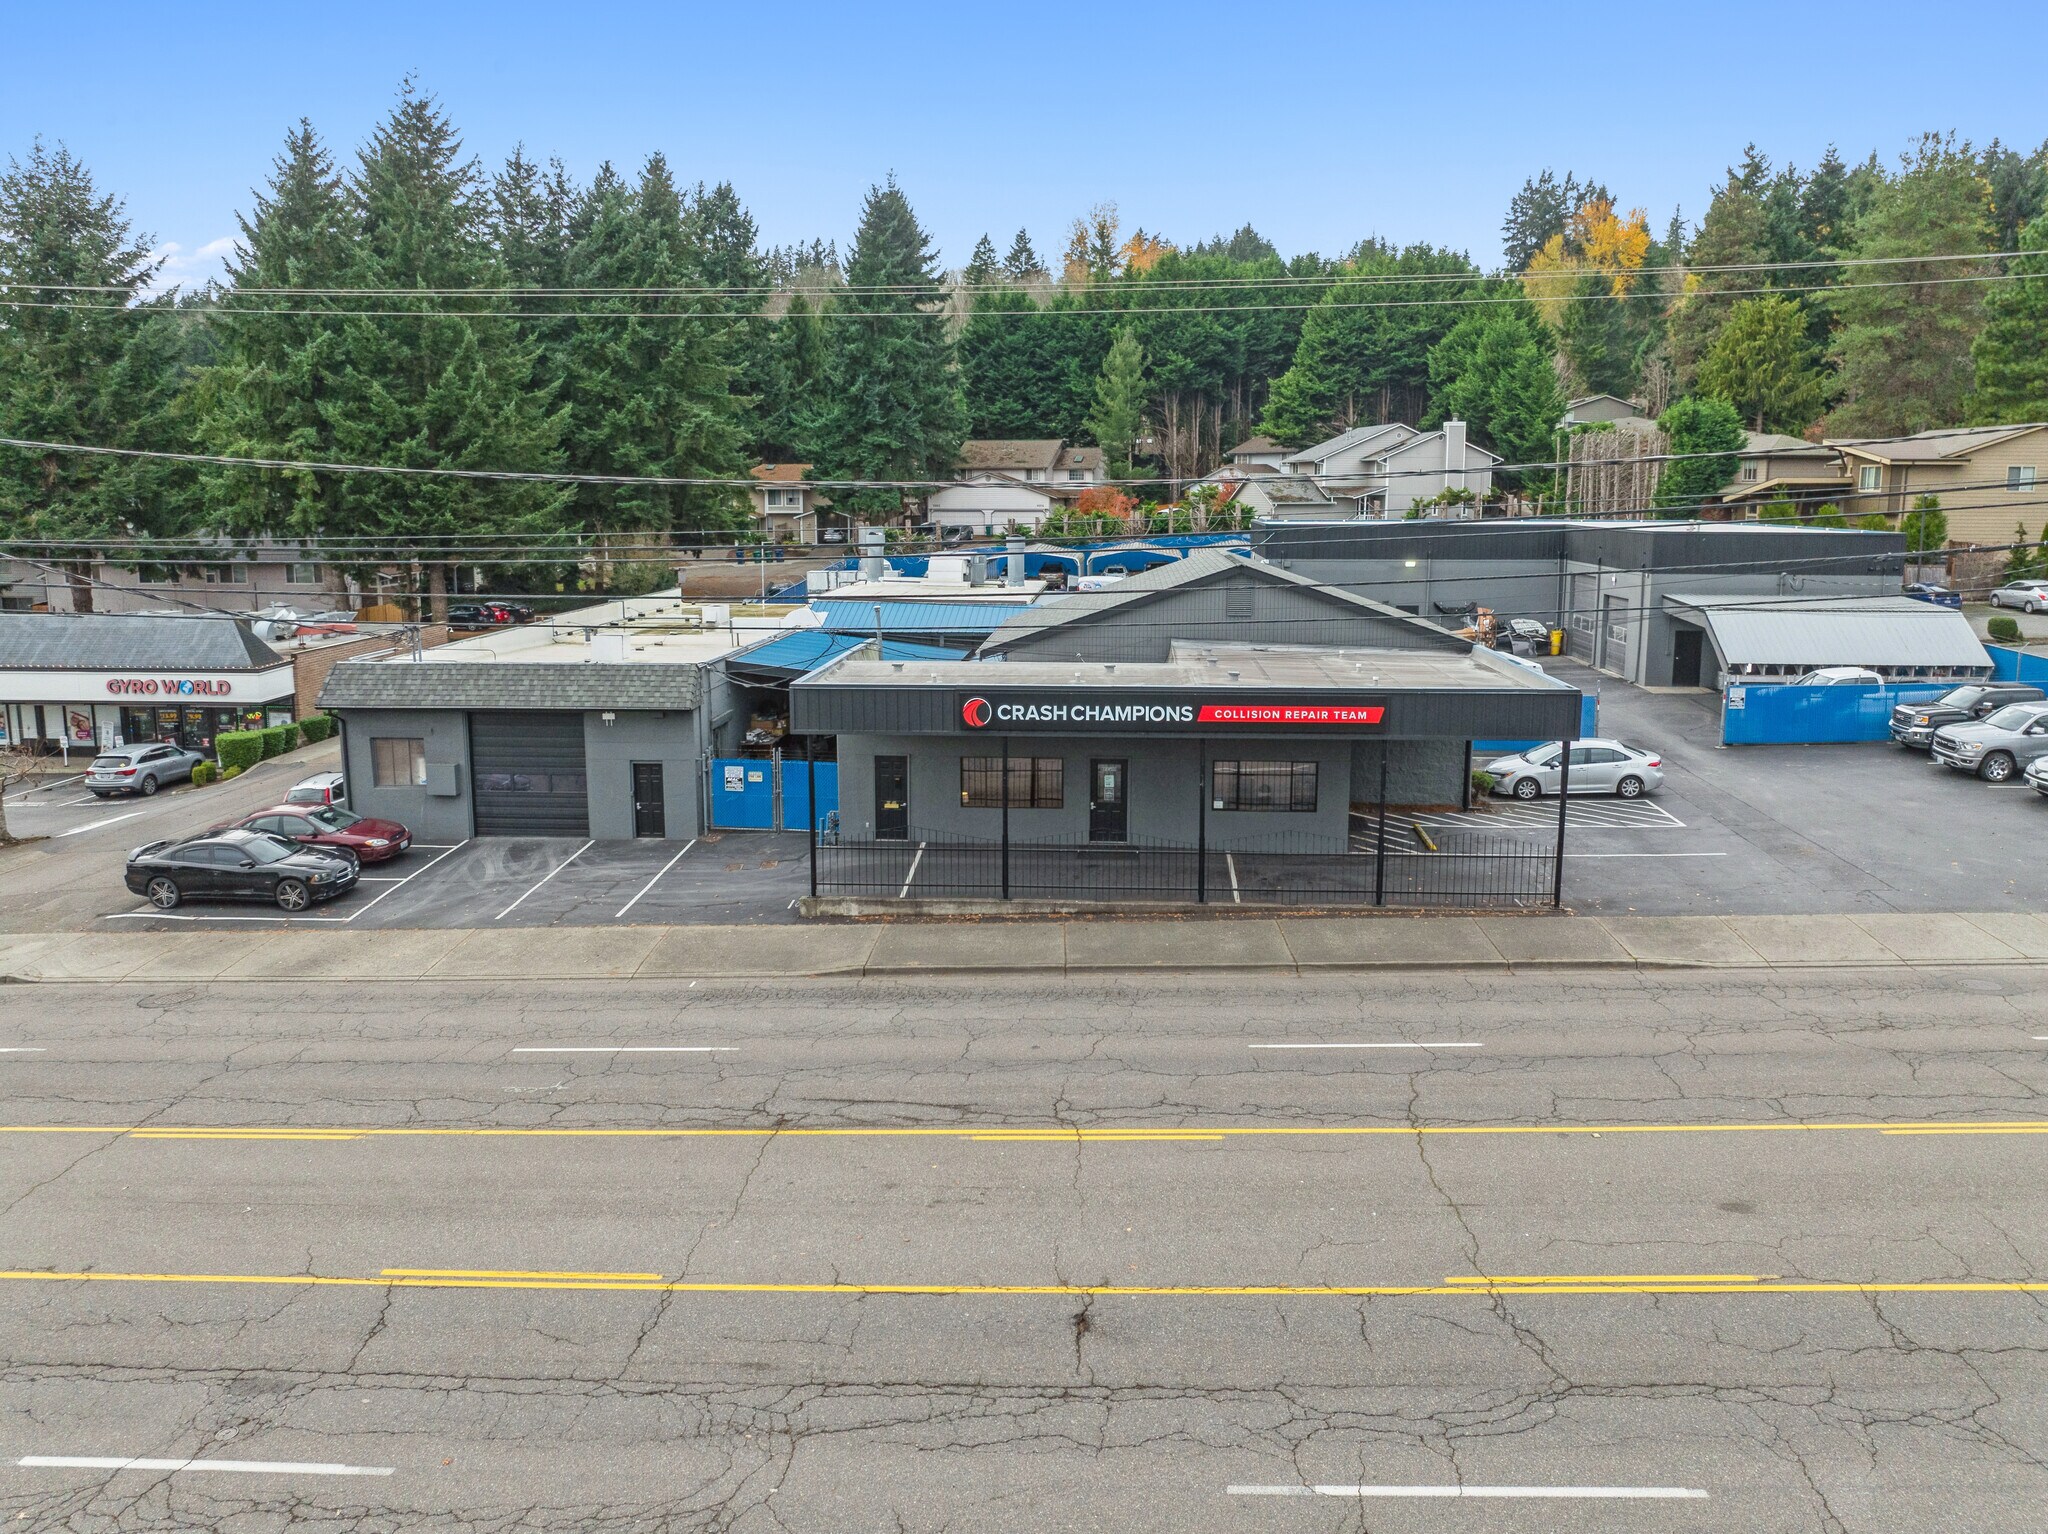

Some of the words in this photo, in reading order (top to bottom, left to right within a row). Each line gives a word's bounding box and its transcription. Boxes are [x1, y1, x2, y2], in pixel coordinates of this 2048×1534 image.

[106, 679, 158, 695] GYRO
[161, 679, 231, 695] WORLD
[997, 704, 1067, 721] CRASH
[1070, 705, 1193, 722] CHAMPIONS
[1214, 709, 1280, 719] COLLISION
[1285, 710, 1328, 720] REPAIR
[1333, 711, 1367, 720] TEAM
